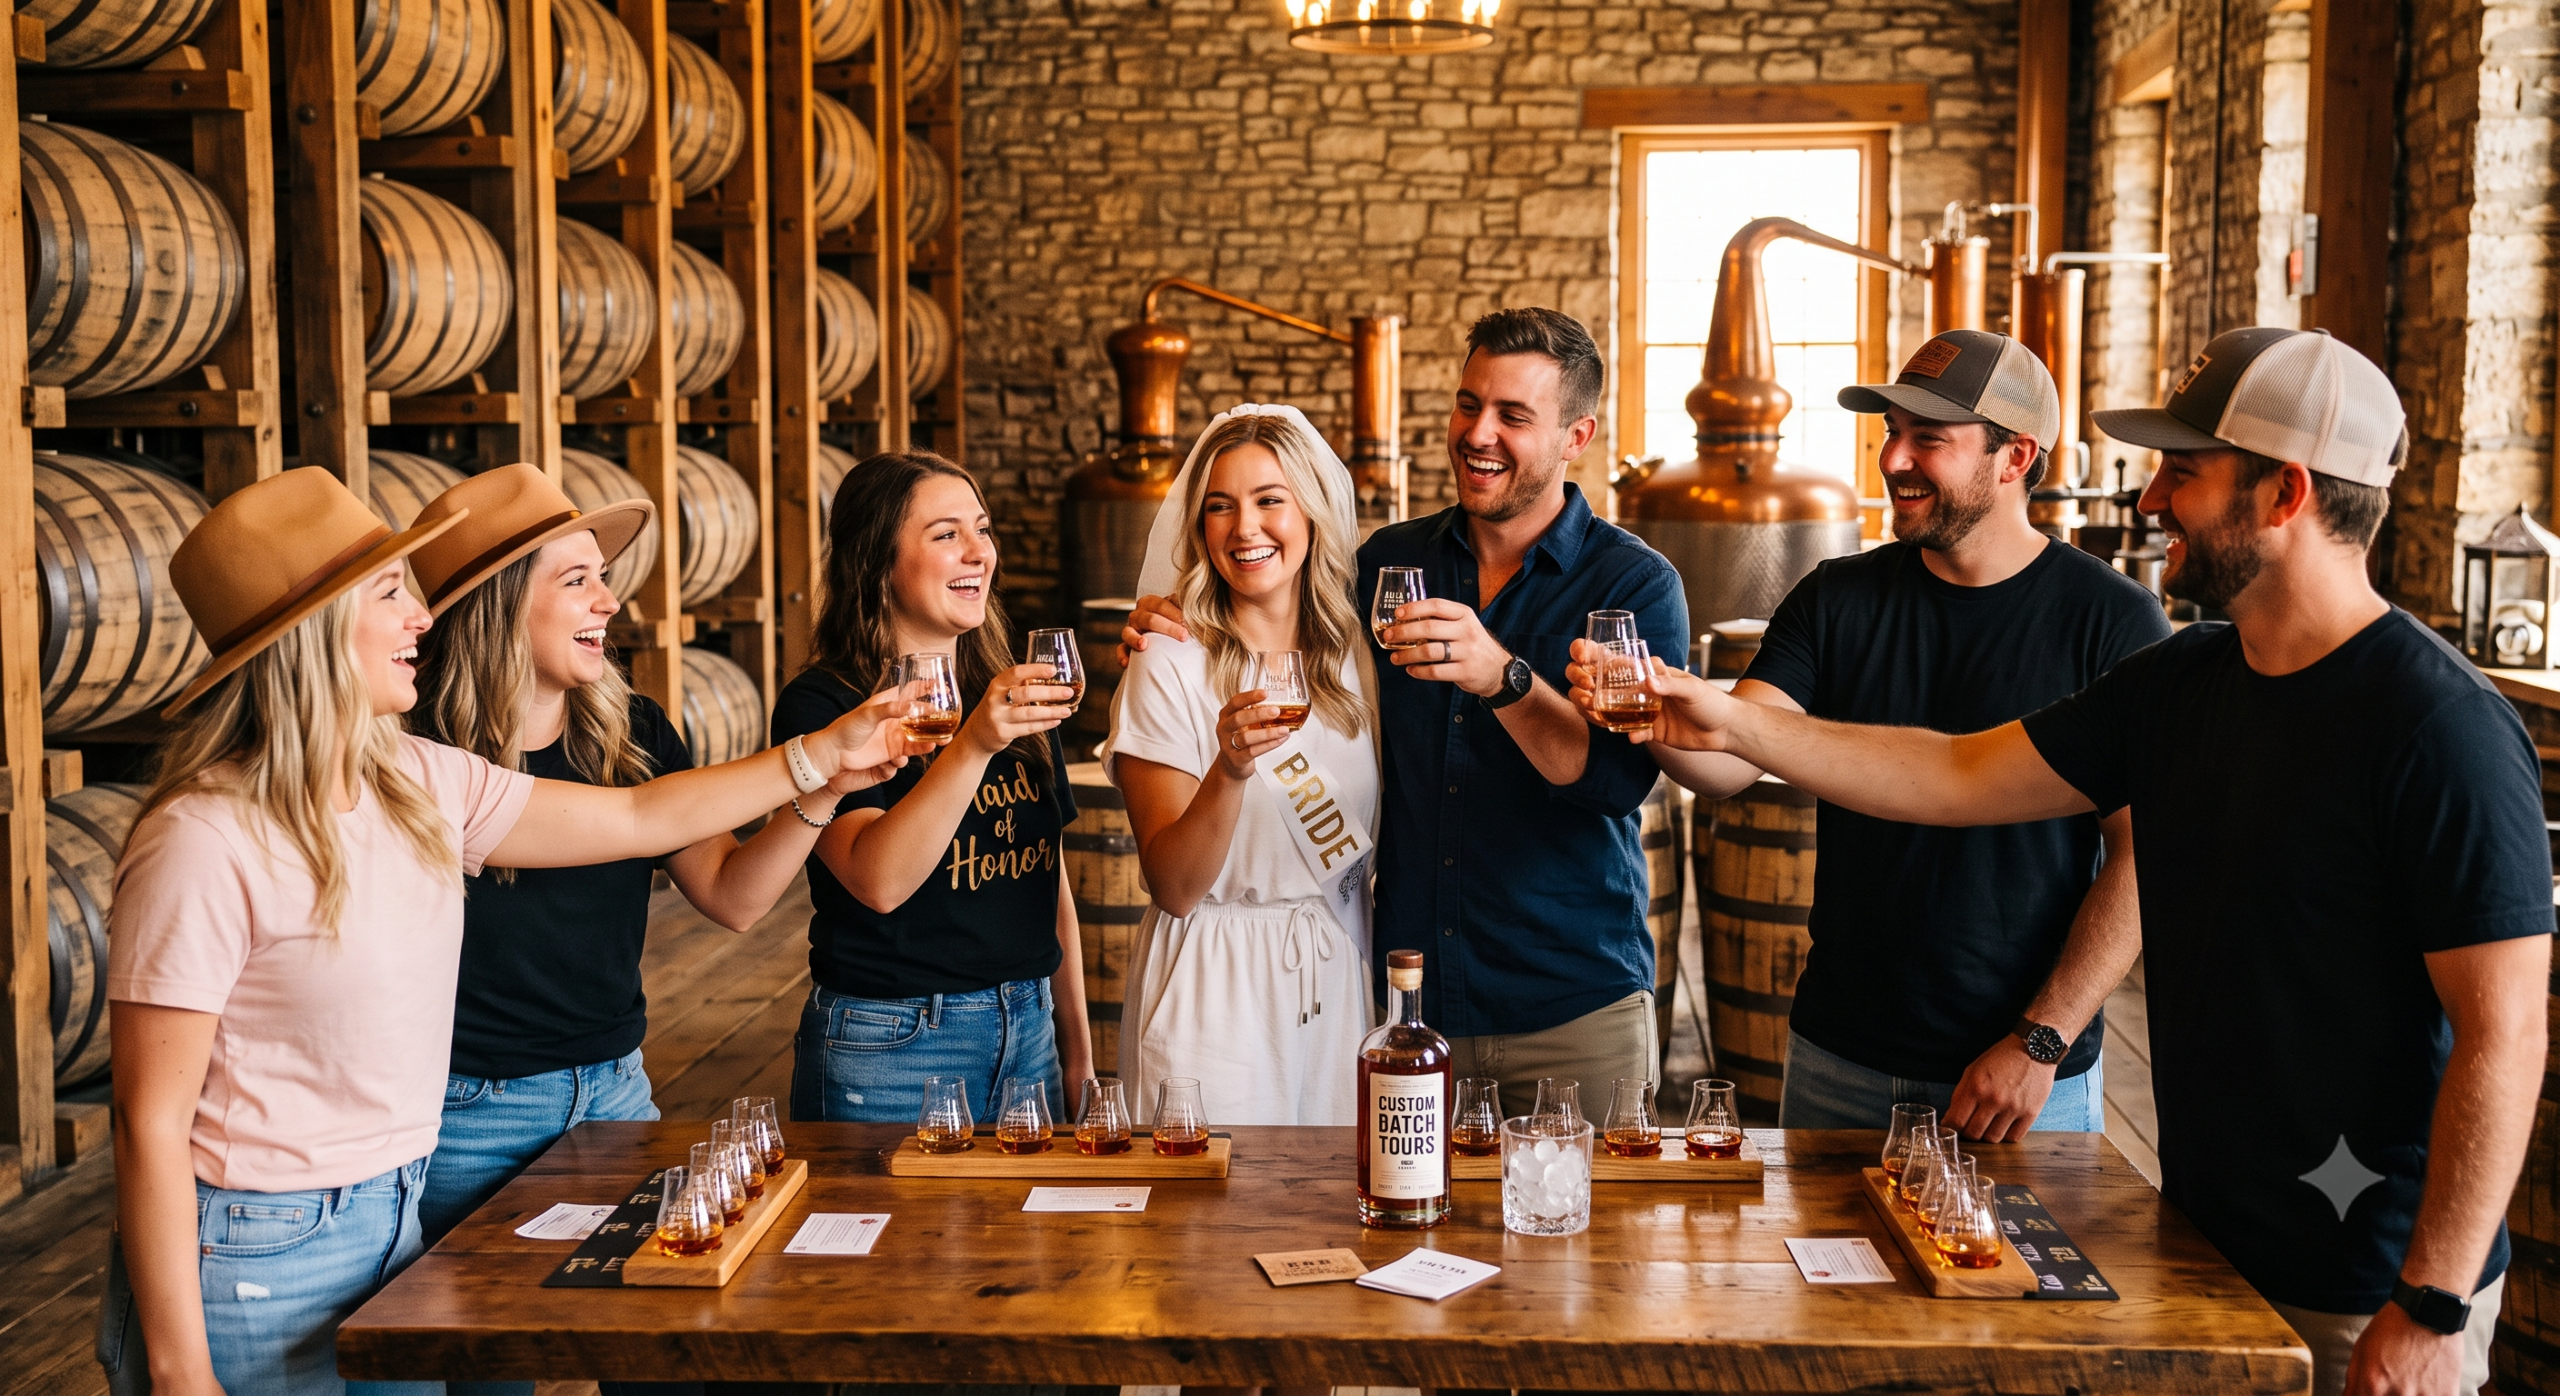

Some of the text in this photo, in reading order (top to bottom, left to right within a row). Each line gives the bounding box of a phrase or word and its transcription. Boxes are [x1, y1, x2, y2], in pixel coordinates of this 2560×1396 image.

[974, 761, 1039, 814] aid
[994, 808, 1017, 843] of
[1272, 751, 1359, 871] BRIDE
[946, 834, 1055, 891] Honor
[1378, 1095, 1435, 1112] CUSTOM
[1378, 1113, 1435, 1134] BATCH
[1378, 1135, 1435, 1155] TOURS
